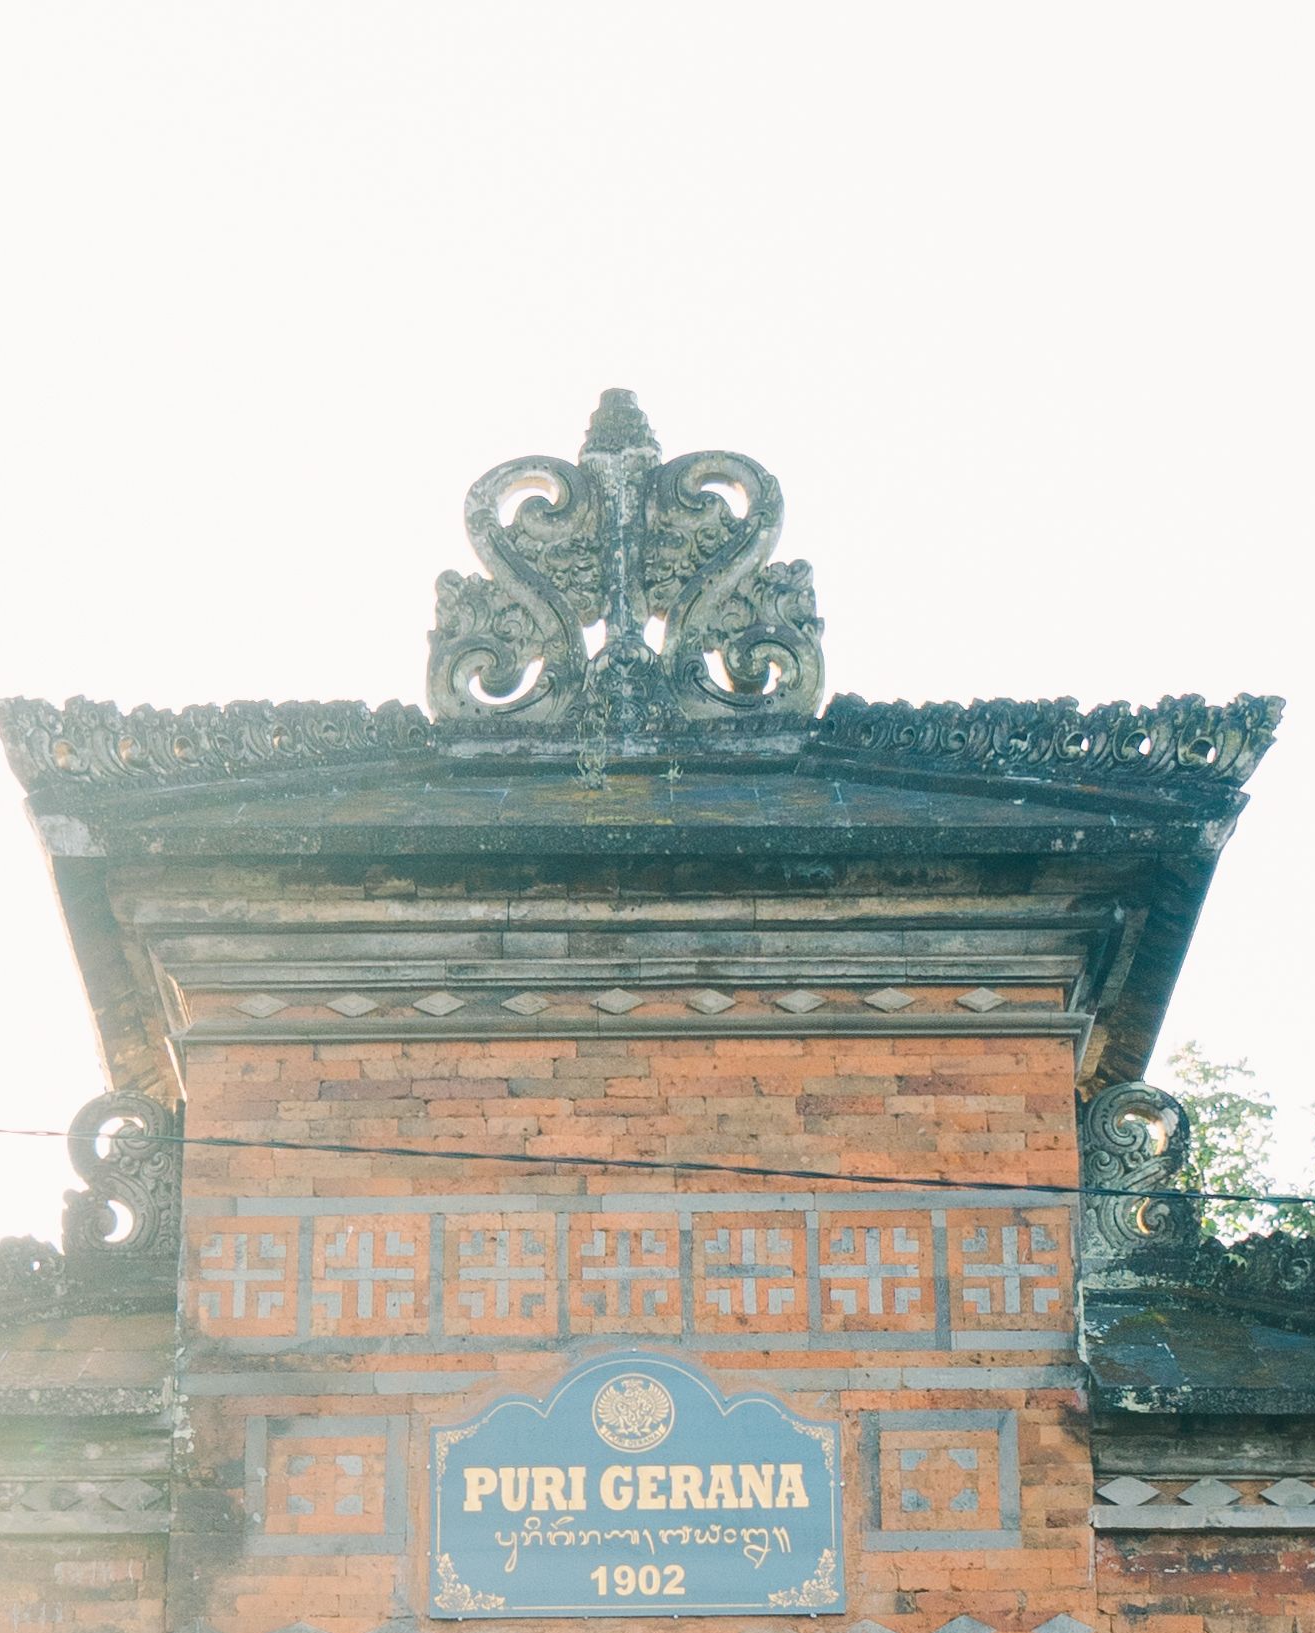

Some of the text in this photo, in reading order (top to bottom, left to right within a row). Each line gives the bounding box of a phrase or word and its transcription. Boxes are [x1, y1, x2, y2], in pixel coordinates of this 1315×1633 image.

[463, 1463, 810, 1512] PURI GERANA
[590, 1564, 686, 1596] 1902
